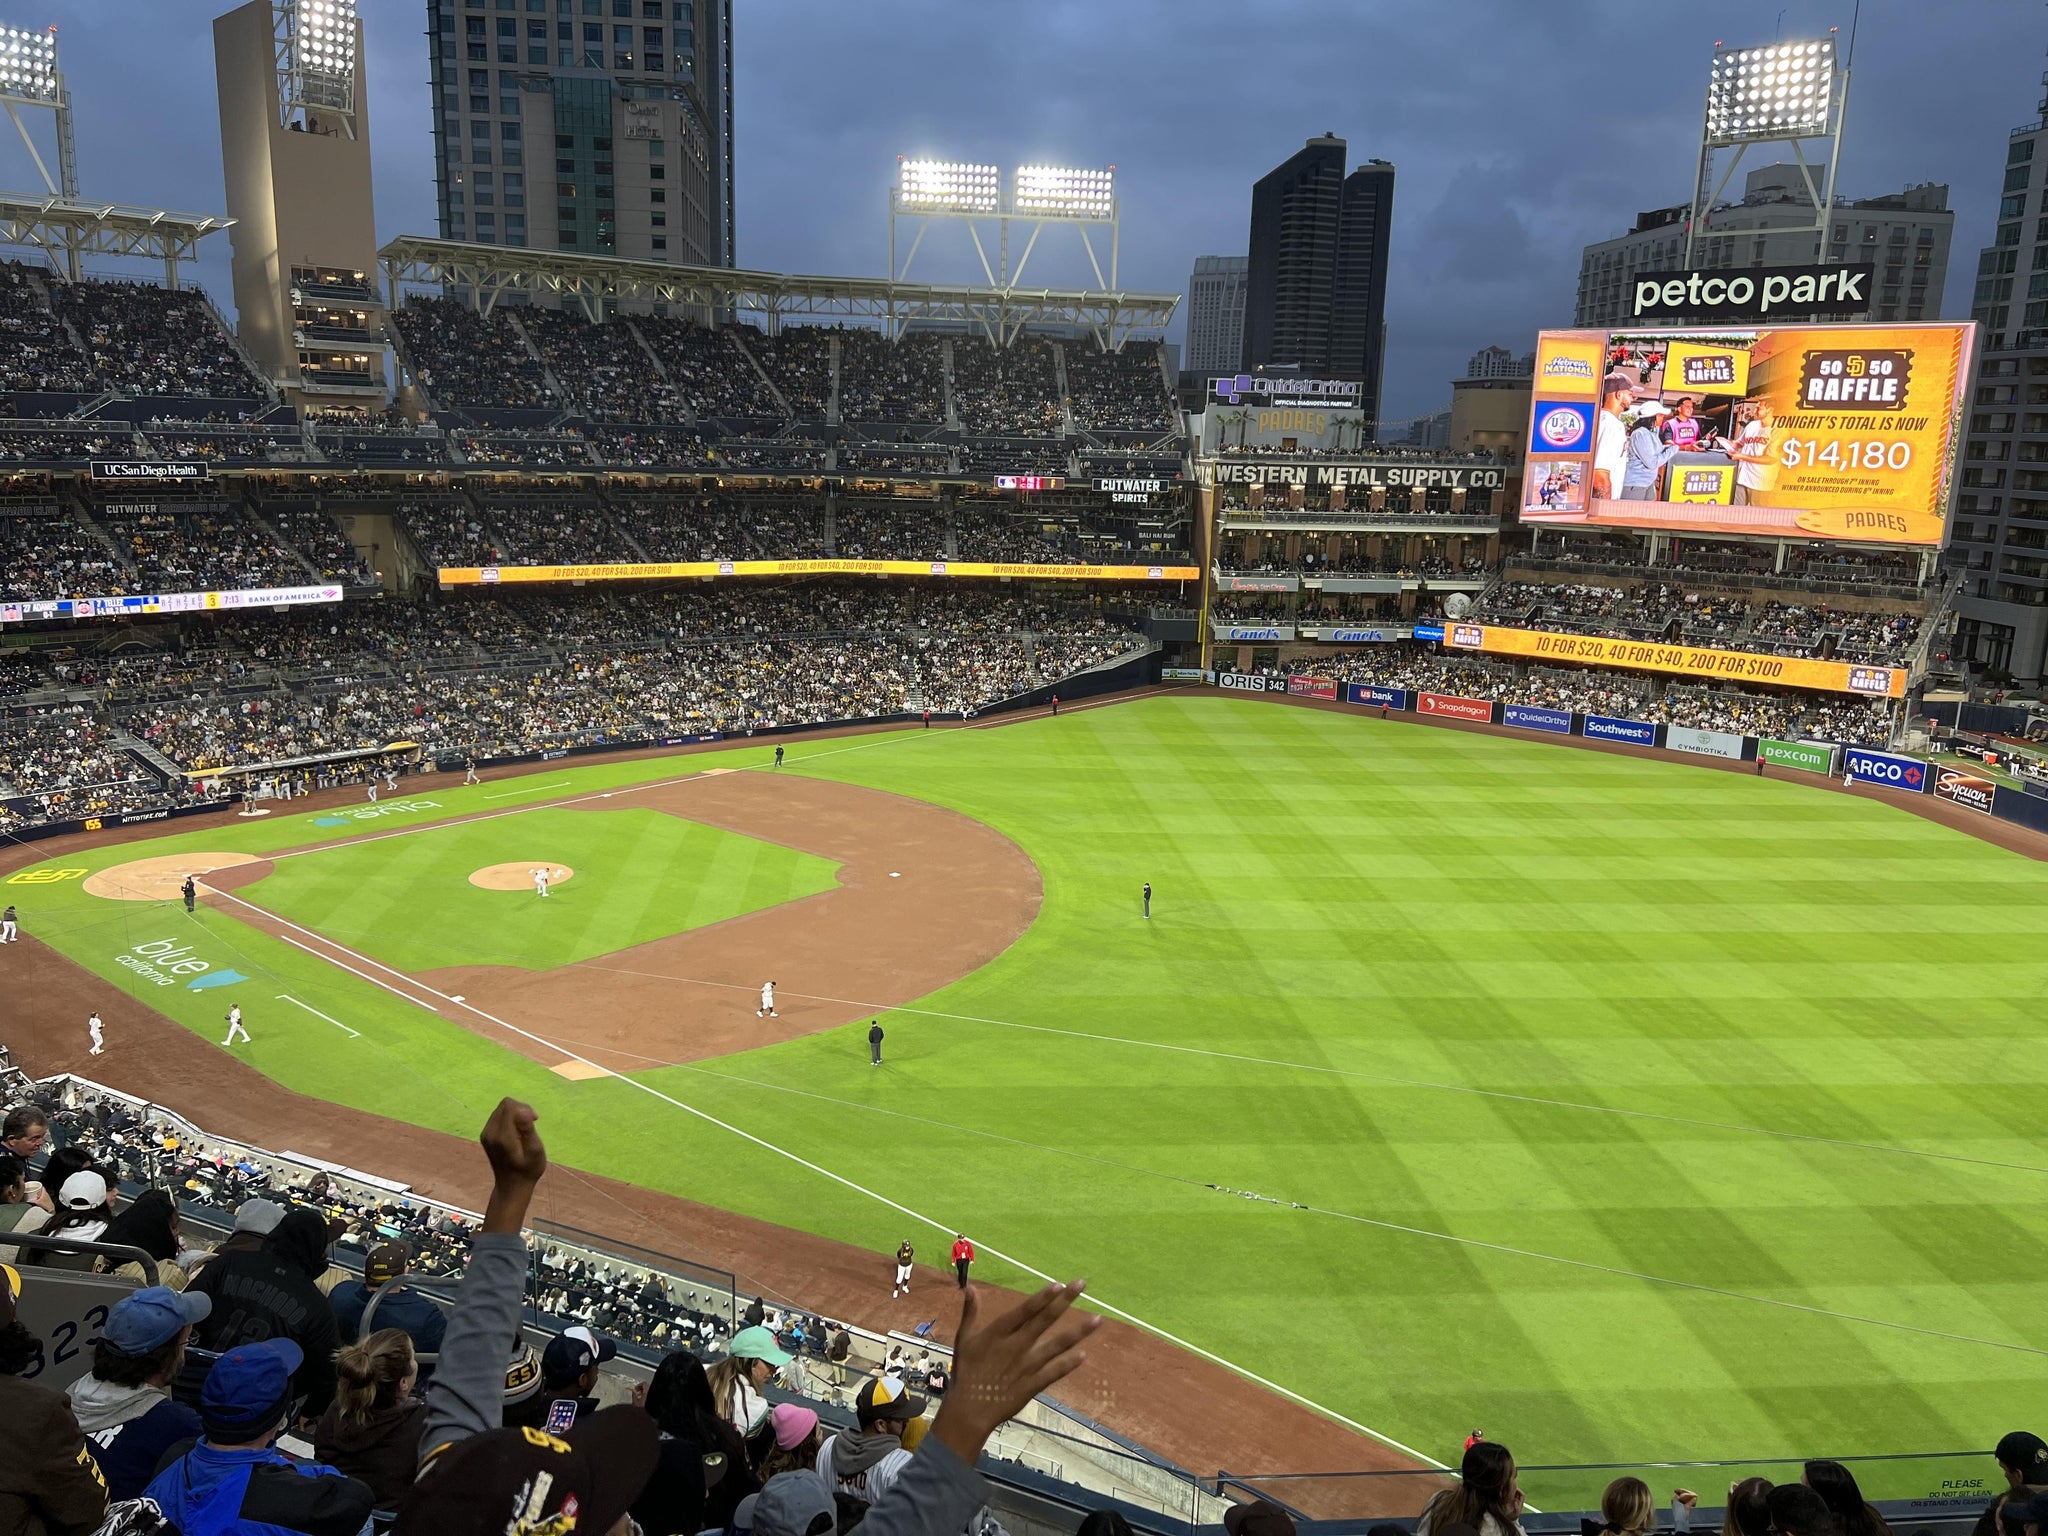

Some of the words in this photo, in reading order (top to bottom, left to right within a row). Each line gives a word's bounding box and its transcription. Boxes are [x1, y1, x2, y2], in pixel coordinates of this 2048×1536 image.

[1634, 272, 1755, 316] petco
[1760, 270, 1866, 312] park
[1552, 357, 1588, 368] Hebrew
[1820, 360, 1842, 376] 50
[1868, 360, 1893, 375] 50
[1544, 364, 1593, 376] NATIONAL
[1688, 368, 1730, 381] RAFFLE
[1255, 378, 1356, 396] QuidelOrtho
[1807, 378, 1898, 402] RAFFLE
[1258, 410, 1326, 436] PADRES
[1771, 416, 1838, 430] TONIGHT'S
[1838, 416, 1876, 430] TOTAL
[1878, 418, 1894, 431] IS
[1894, 418, 1928, 432] NOW
[1780, 438, 1911, 472] $14,180
[104, 465, 121, 475] UC
[122, 465, 140, 475] San
[140, 465, 168, 477] Diego
[168, 465, 198, 476] Health
[1216, 465, 1308, 484] WESTERN
[1318, 467, 1381, 486] METAL
[1387, 468, 1462, 487] SUPPLY
[1470, 470, 1502, 488] CO.
[1100, 480, 1160, 492] CUTWATER
[1686, 481, 1718, 492] RAFFLE
[1804, 485, 1840, 493] ANNOUNCED
[1112, 494, 1148, 503] SPIRITS
[106, 504, 158, 514] CUTWATER
[1846, 512, 1907, 533] PADRES
[554, 569, 561, 577] 10
[562, 568, 575, 577] FOR
[576, 568, 590, 577] $20,
[602, 568, 614, 576] FOR
[614, 568, 629, 576] $40,
[630, 567, 643, 575] 200
[644, 566, 656, 574] FOR
[656, 566, 672, 574] $100
[1684, 584, 1715, 592] JALISCO
[1717, 585, 1753, 595] LANDING
[210, 598, 216, 607] 3
[224, 596, 239, 604] 7:13
[285, 593, 322, 601] AMERICA
[1230, 627, 1280, 640] Canel's
[1334, 629, 1383, 640] Canel's
[1454, 634, 1480, 644] RAFFLE
[1536, 637, 1551, 651] 10
[1551, 638, 1576, 652] FOR
[1578, 640, 1605, 660] $20,
[1609, 645, 1627, 660] 40
[1628, 646, 1654, 662] FOR
[1655, 648, 1684, 668] $40,
[1687, 653, 1718, 670] 200
[1717, 656, 1746, 673] FOR
[1746, 659, 1783, 678] $100
[1222, 674, 1264, 690] ORIS
[1268, 680, 1284, 691] 342
[1852, 678, 1886, 690] RAFFLE
[1372, 691, 1393, 702] bank
[1438, 702, 1486, 716] Snapdragon
[1520, 712, 1568, 726] QuidelOrtho
[1588, 722, 1642, 738] Southwest
[1678, 744, 1728, 756] CYMBIOTIKA
[1850, 757, 1902, 780] ARCO
[1938, 772, 1986, 802] Sycuan
[354, 800, 443, 818] blue
[85, 818, 102, 830] 155
[132, 937, 210, 975] blue
[114, 955, 175, 986] california
[1942, 1479, 1984, 1489] PLEASE
